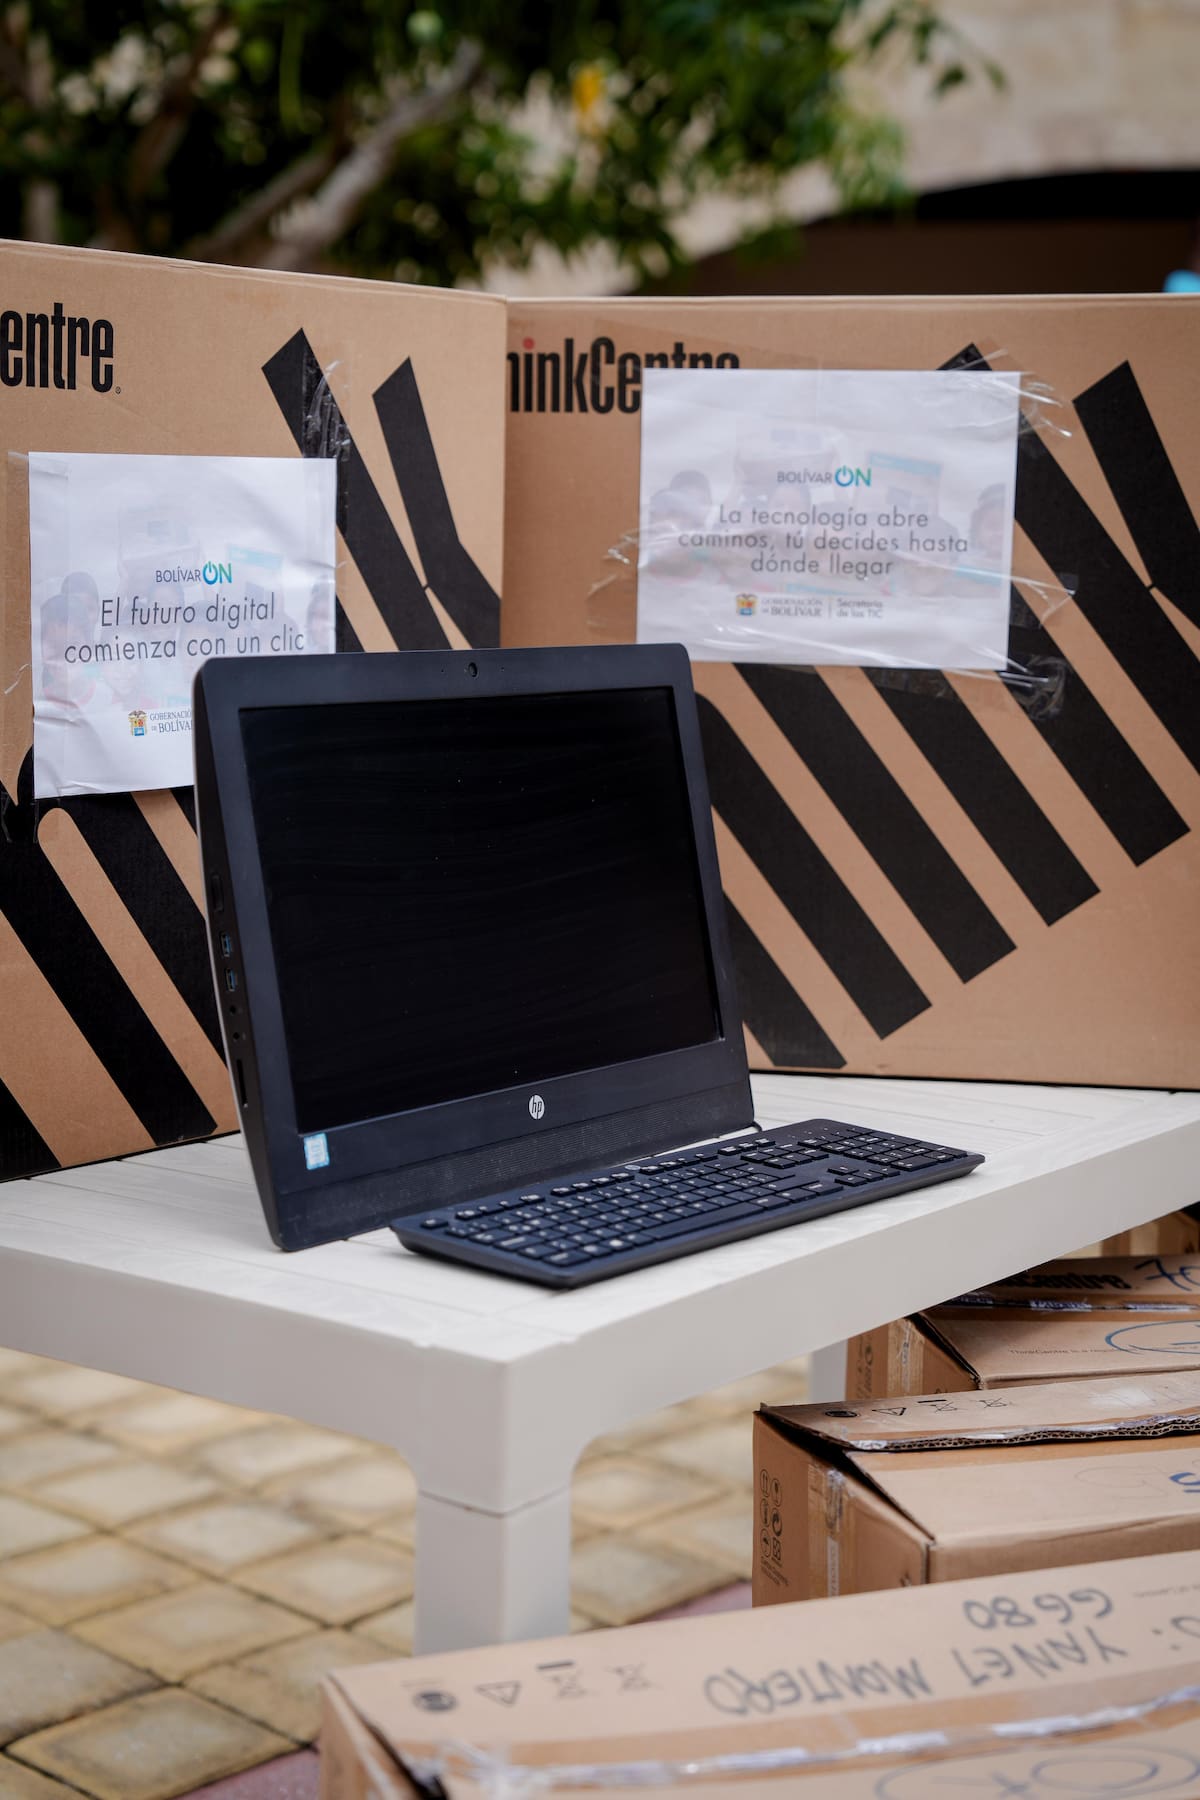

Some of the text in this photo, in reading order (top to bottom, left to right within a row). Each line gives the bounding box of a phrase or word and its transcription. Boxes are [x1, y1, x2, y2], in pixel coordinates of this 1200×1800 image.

[777, 470, 832, 484] BOLÍVAR
[719, 504, 929, 532] La tecnología abre
[678, 527, 968, 552] caminos, tú decides hasta
[155, 566, 201, 583] BOLÍVAR
[750, 552, 894, 581] dónde llegar
[101, 591, 275, 629] El futuro digital
[64, 624, 304, 664] comienza con un clic
[159, 719, 193, 734] BOLÍVA
[951, 1625, 1129, 1689] YANET
[704, 1659, 932, 1718] MONTERO
